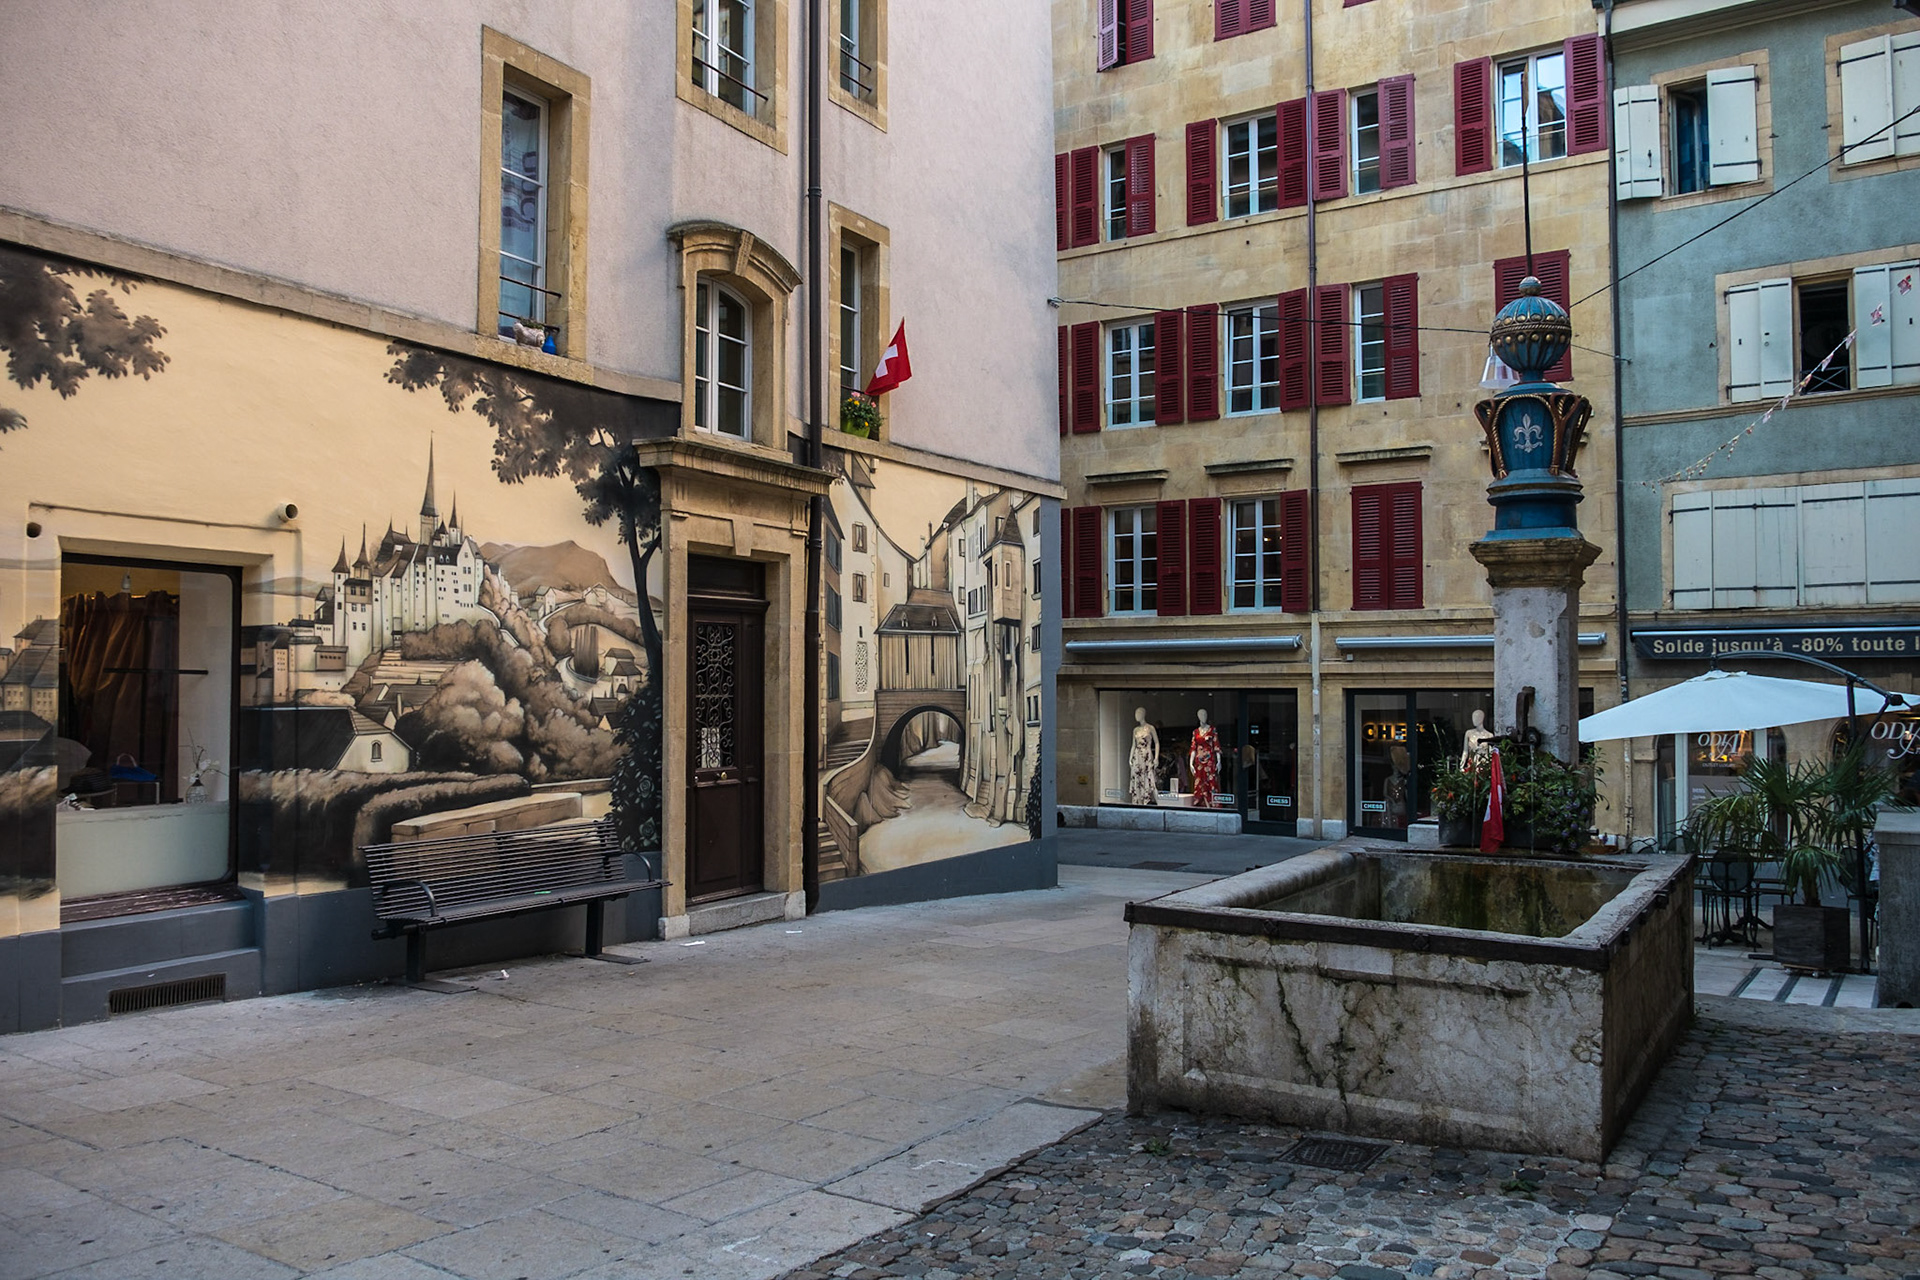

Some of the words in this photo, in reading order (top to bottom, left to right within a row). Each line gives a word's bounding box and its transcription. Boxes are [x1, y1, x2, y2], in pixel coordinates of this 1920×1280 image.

[1653, 639, 1704, 653] Solde
[1792, 637, 1844, 653] -80%
[1852, 636, 1905, 652] toute
